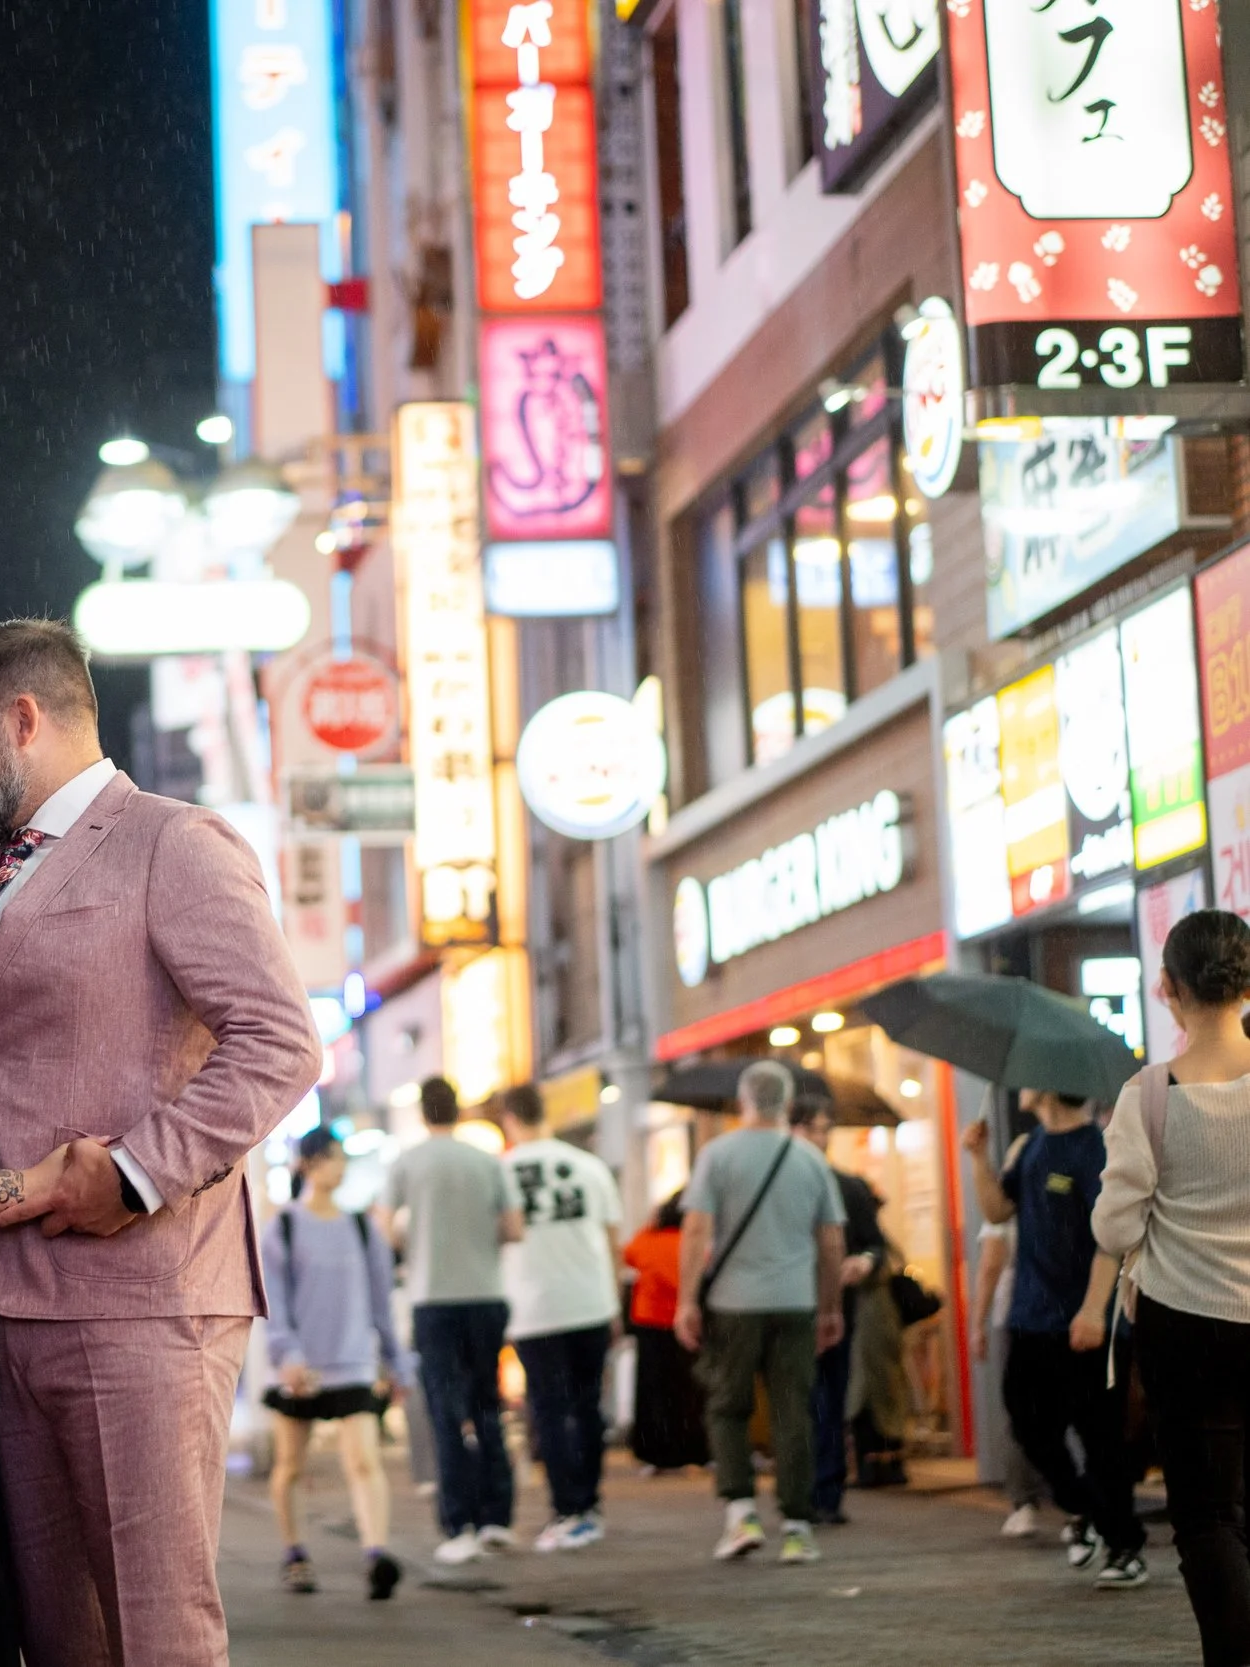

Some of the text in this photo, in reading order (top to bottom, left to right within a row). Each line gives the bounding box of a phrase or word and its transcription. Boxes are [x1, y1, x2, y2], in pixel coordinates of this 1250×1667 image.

[1030, 0, 1125, 144] フェ
[707, 832, 821, 964] BURGER
[815, 789, 903, 916] KING
